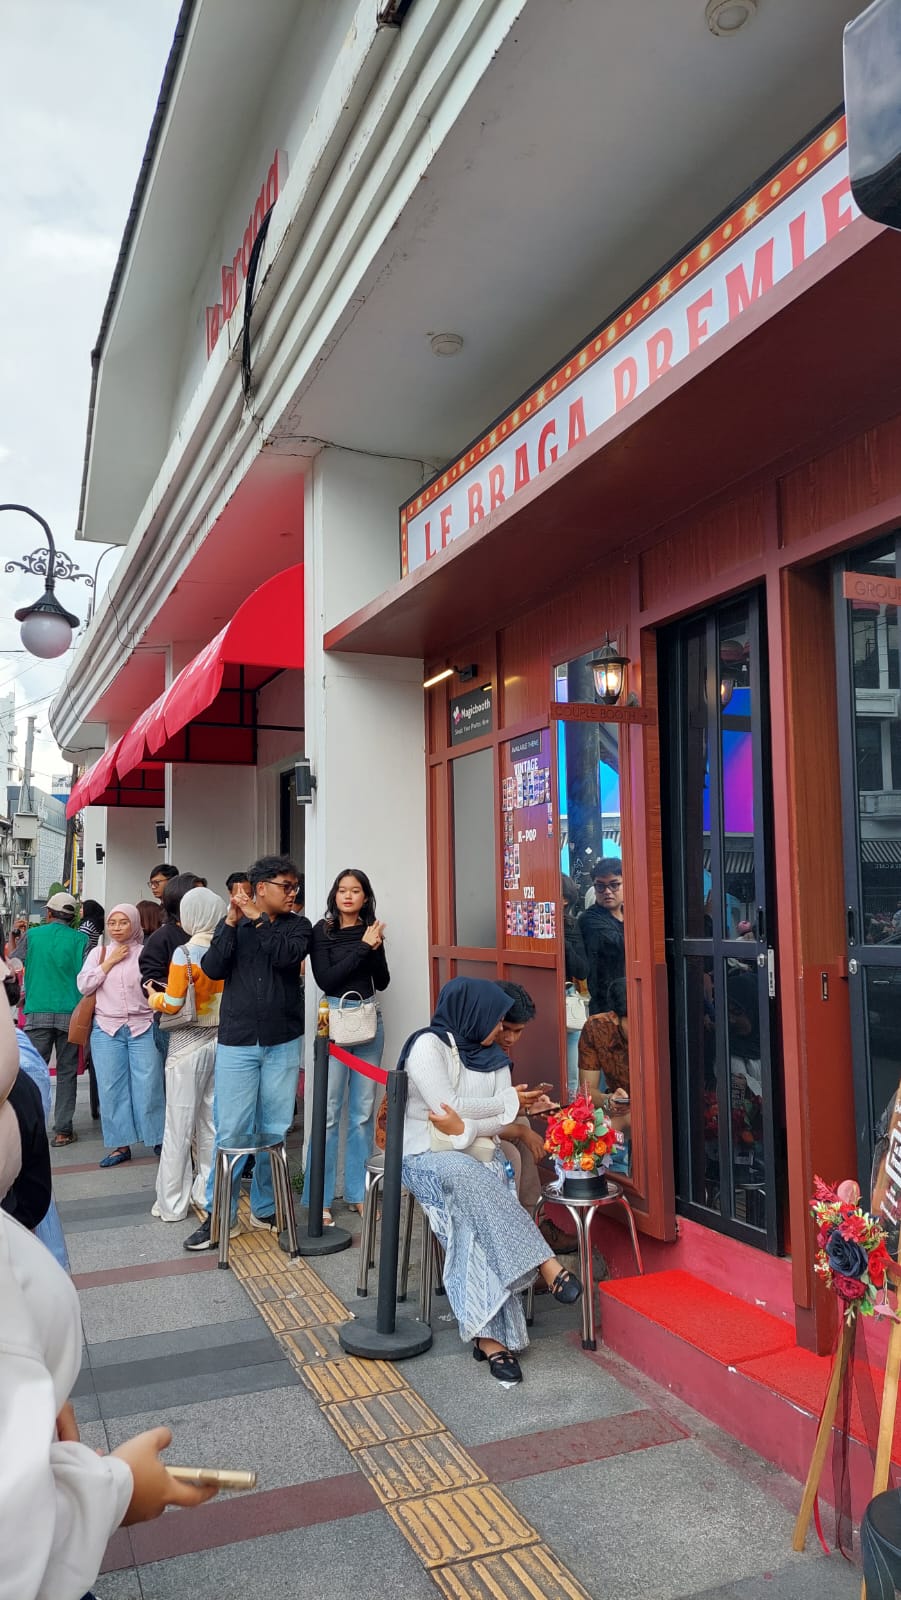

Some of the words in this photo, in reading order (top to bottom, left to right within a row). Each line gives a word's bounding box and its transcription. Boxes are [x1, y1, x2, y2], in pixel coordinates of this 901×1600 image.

[424, 503, 453, 562] LE
[467, 396, 588, 529] BRAGA
[461, 697, 491, 719] Magicbooth
[513, 757, 538, 776] VINTAGE
[517, 828, 537, 843] K-POP
